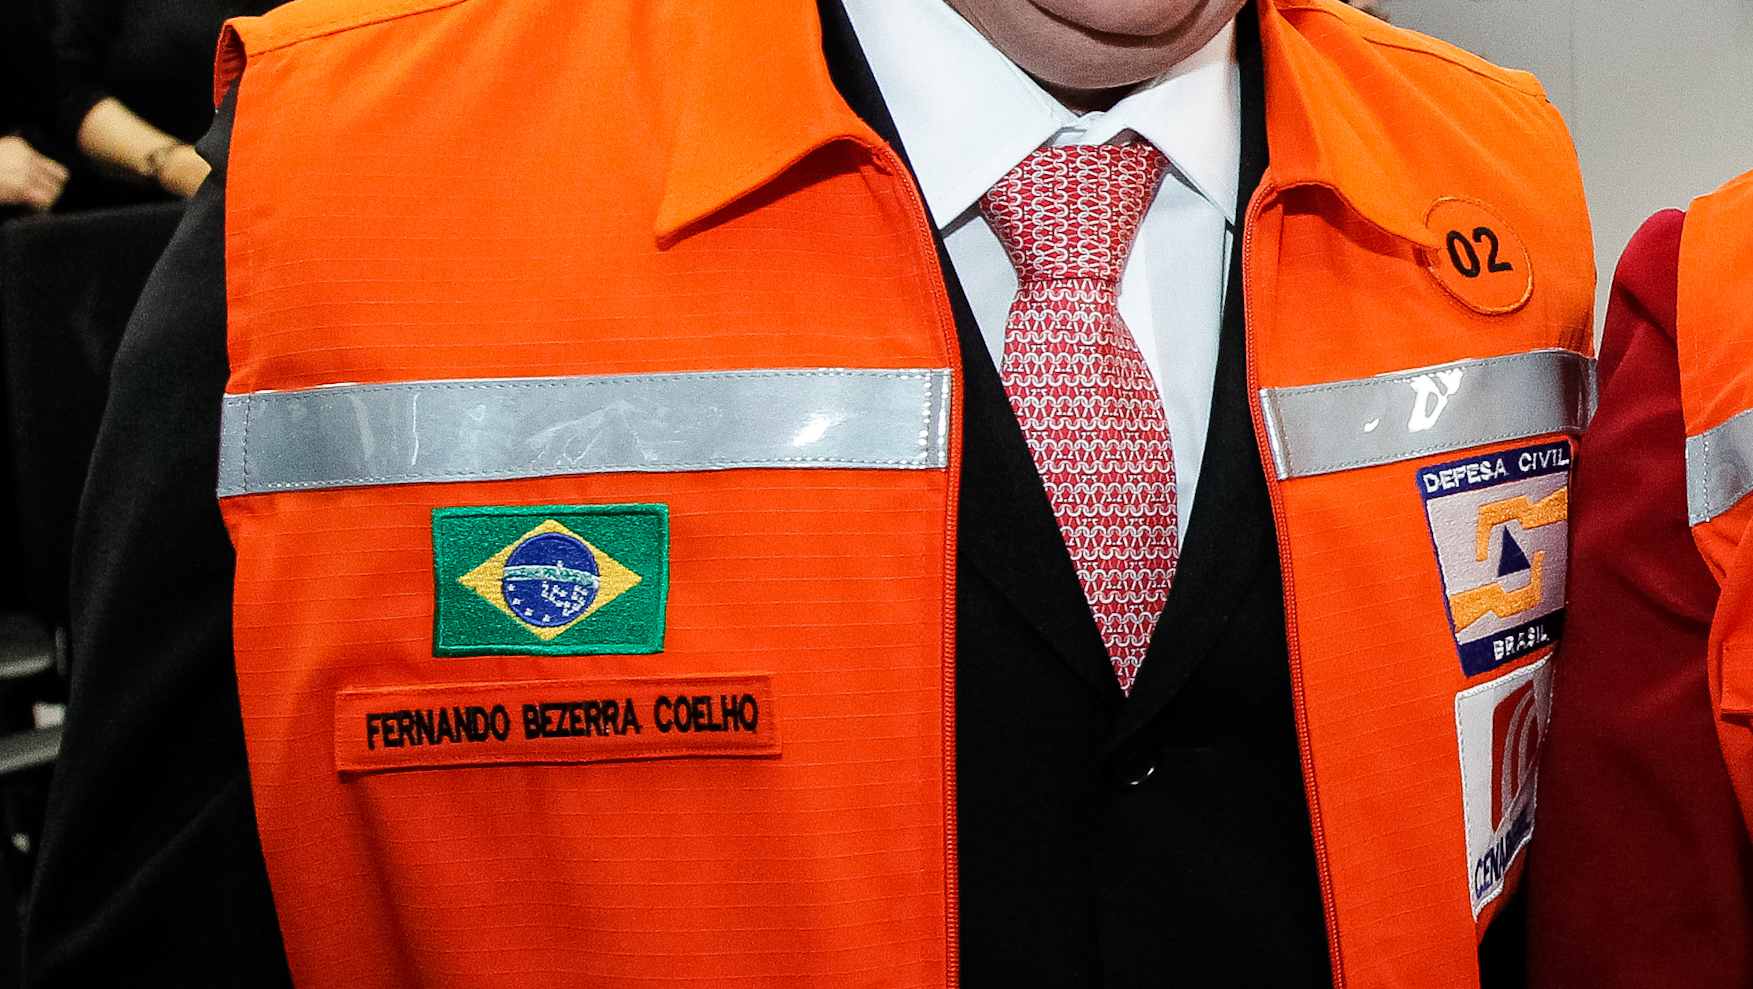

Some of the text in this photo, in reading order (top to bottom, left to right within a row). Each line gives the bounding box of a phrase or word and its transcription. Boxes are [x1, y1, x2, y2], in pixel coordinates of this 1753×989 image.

[1446, 226, 1512, 278] 02
[1422, 447, 1571, 493] DEFESA CIVIL
[1493, 624, 1550, 661] BRASIL
[366, 693, 758, 749] FERNANDO BEZERRA COELHO
